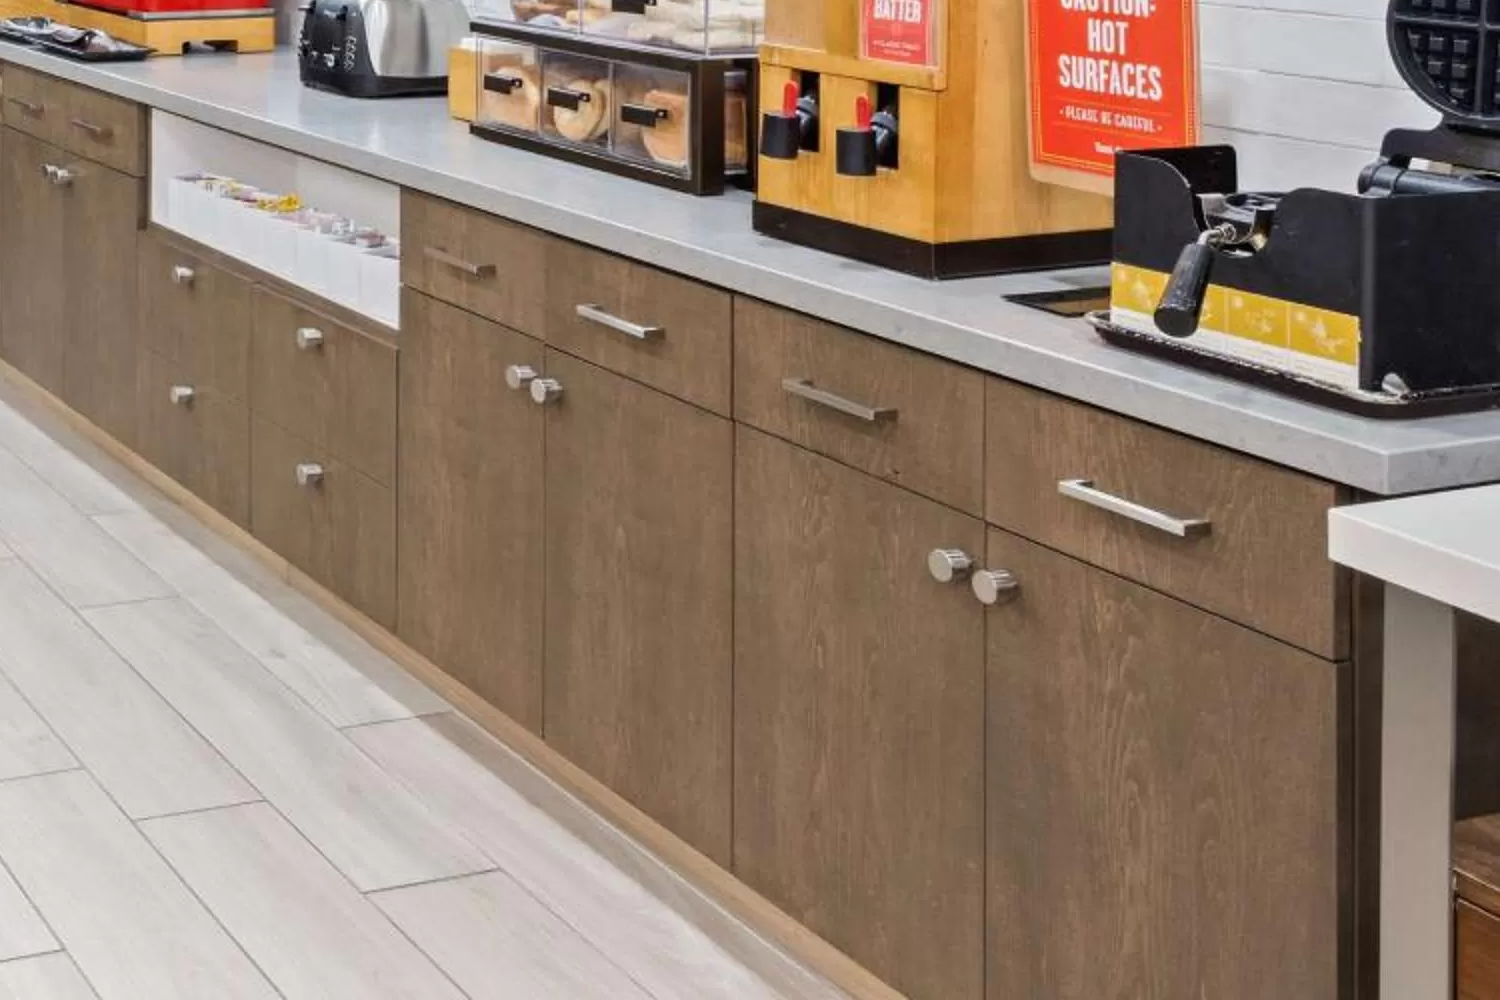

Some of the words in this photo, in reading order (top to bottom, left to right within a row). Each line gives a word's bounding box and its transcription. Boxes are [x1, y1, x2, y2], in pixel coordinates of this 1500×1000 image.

[1087, 18, 1129, 56] HOT
[1058, 53, 1163, 101] SURFACES
[1065, 105, 1099, 123] PLEASE
